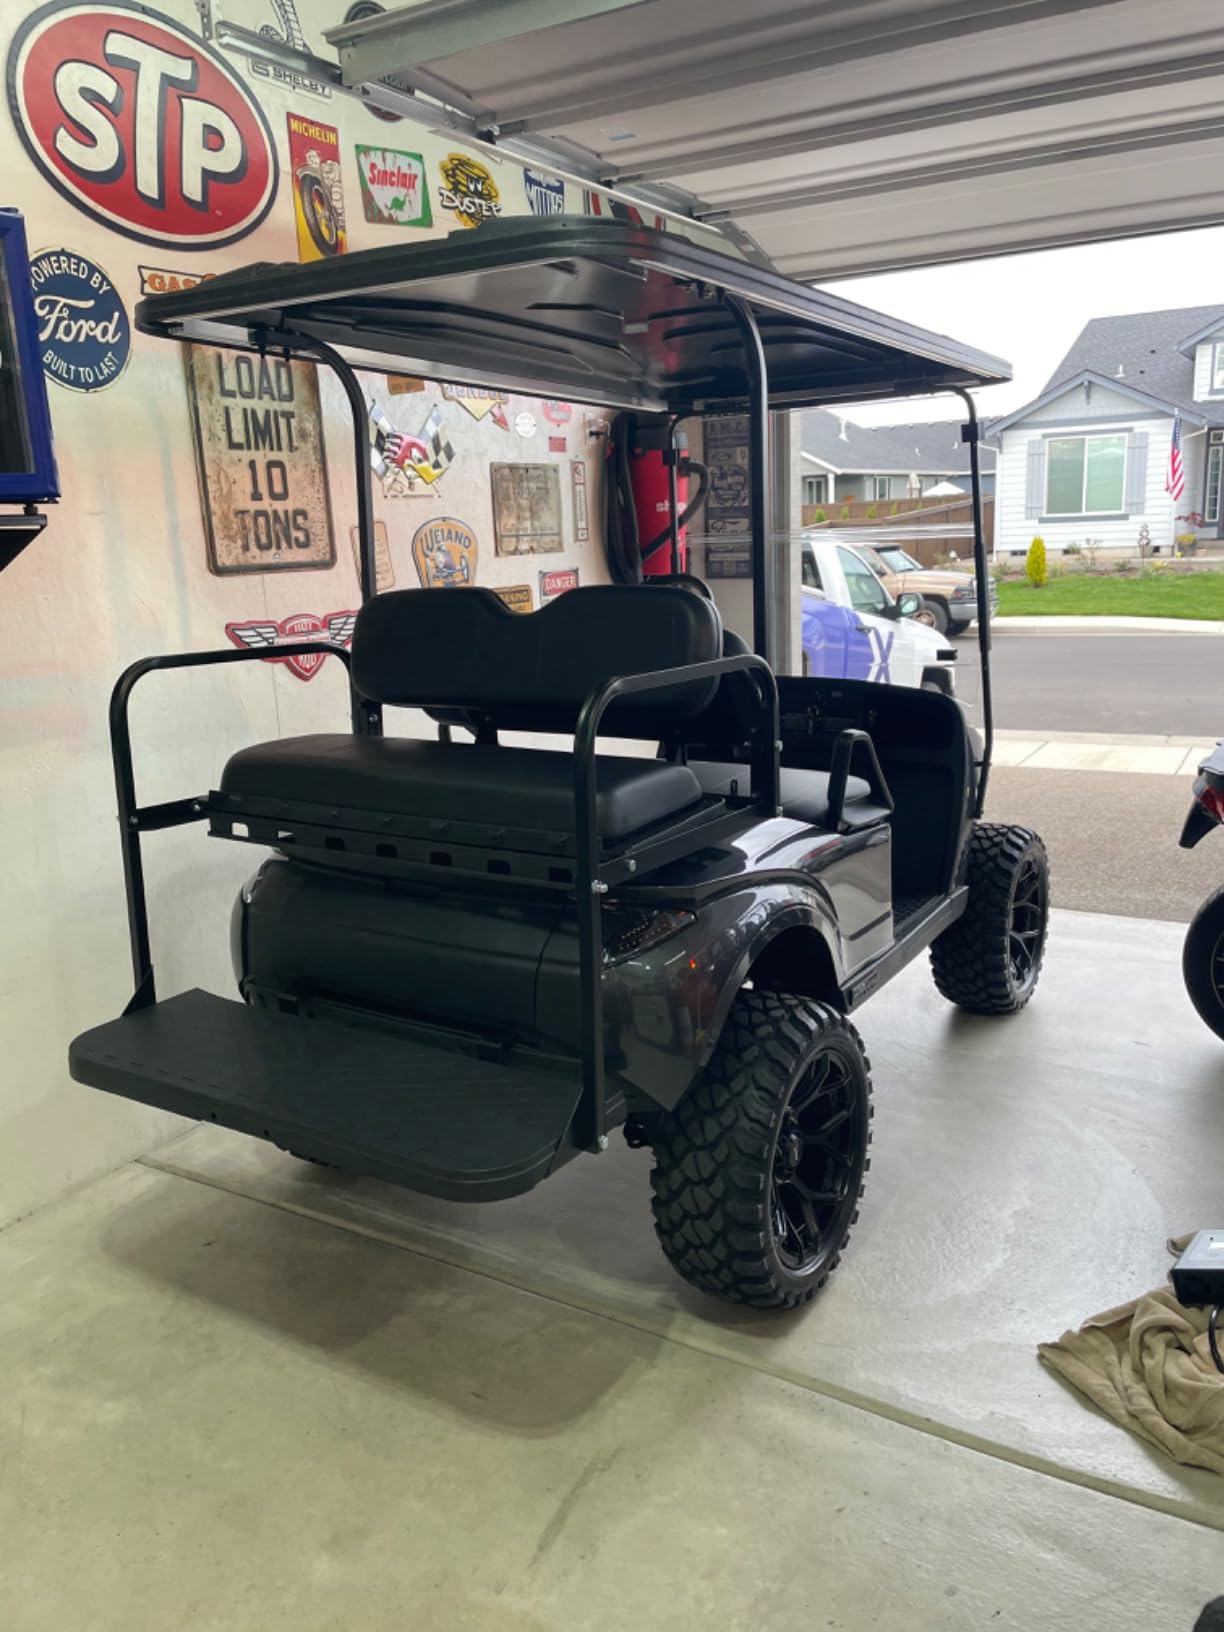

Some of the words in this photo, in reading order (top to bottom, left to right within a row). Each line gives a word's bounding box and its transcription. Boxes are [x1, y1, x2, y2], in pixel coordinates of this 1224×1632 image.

[273, 64, 327, 94] SHELBY
[54, 30, 246, 208] STP
[290, 118, 337, 145] MICHELIN
[368, 162, 418, 190] Sinclair
[440, 187, 501, 217] DUSTER
[90, 272, 111, 294] BY
[34, 295, 121, 343] Ford
[42, 350, 75, 380] BUILT
[78, 367, 93, 383] TO
[95, 351, 119, 380] LAST
[217, 352, 294, 402] LOAD
[224, 406, 296, 453] LIMIT
[249, 459, 289, 501] 10
[234, 508, 311, 552] TONS
[545, 576, 577, 591] DANGER
